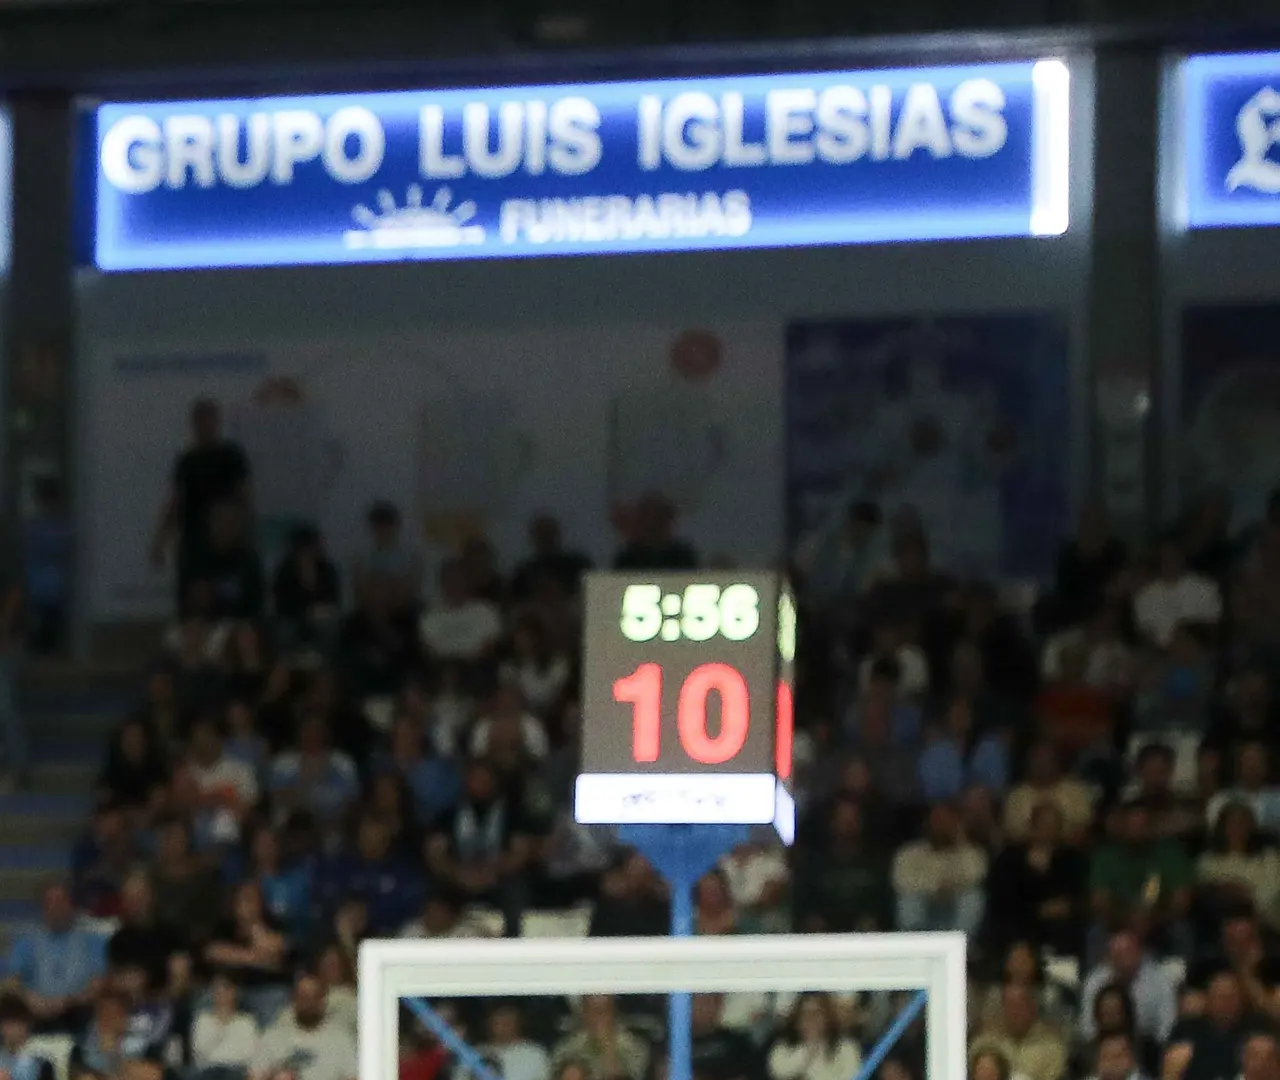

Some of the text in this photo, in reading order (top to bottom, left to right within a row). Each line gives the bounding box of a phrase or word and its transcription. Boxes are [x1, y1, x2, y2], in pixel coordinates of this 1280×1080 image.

[100, 78, 1008, 198] GRUPO LUIS IGLESIAS
[498, 189, 752, 242] FUNERARIAS
[619, 584, 760, 641] 5:56
[612, 661, 751, 764] 10
